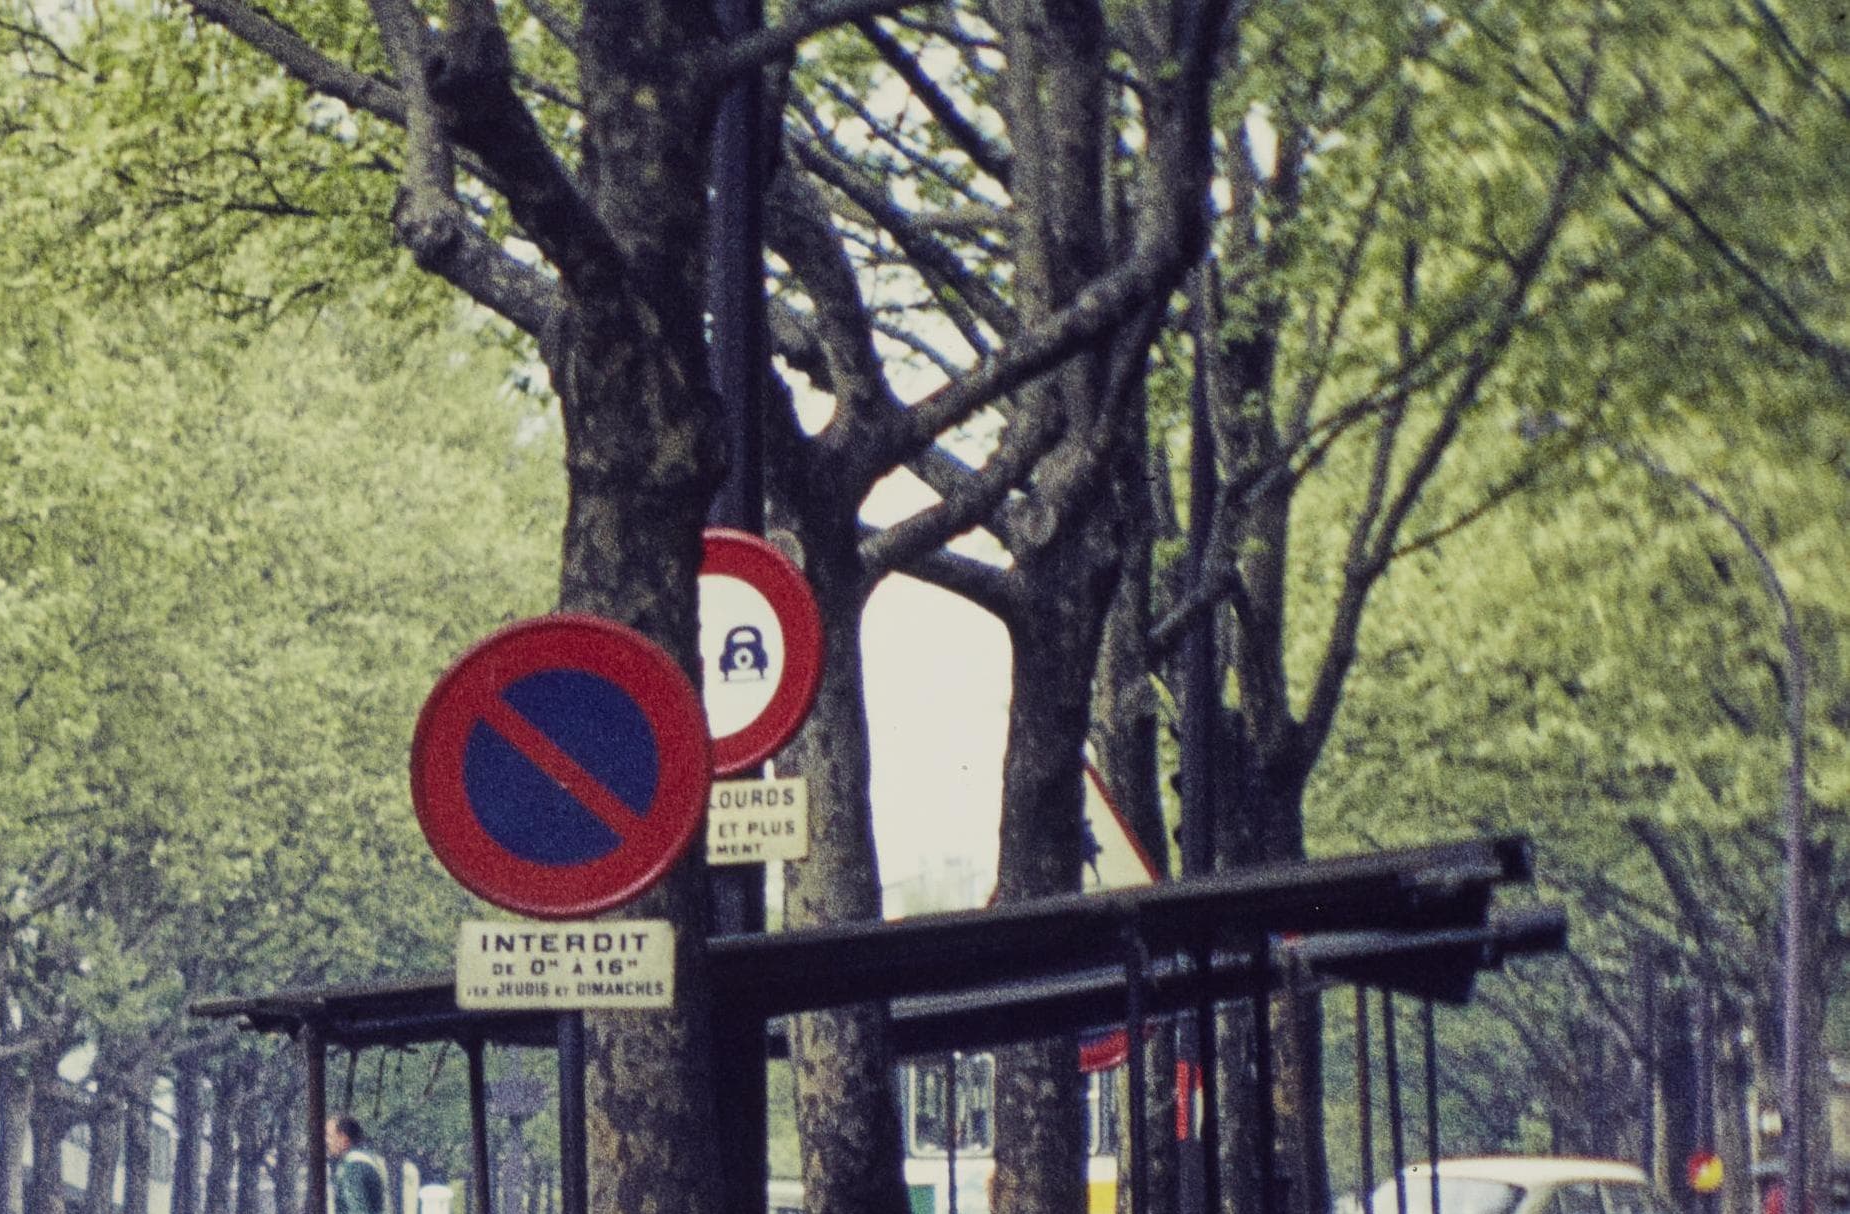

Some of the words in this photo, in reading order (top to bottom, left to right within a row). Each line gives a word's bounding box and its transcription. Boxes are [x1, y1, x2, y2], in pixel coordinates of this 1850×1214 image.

[718, 822, 738, 838] ET
[748, 820, 795, 837] PLUS
[481, 933, 648, 953] INTERDIT
[492, 962, 514, 976] DE
[497, 981, 549, 996] JEUDIS
[577, 981, 665, 996] DIMANCHES
